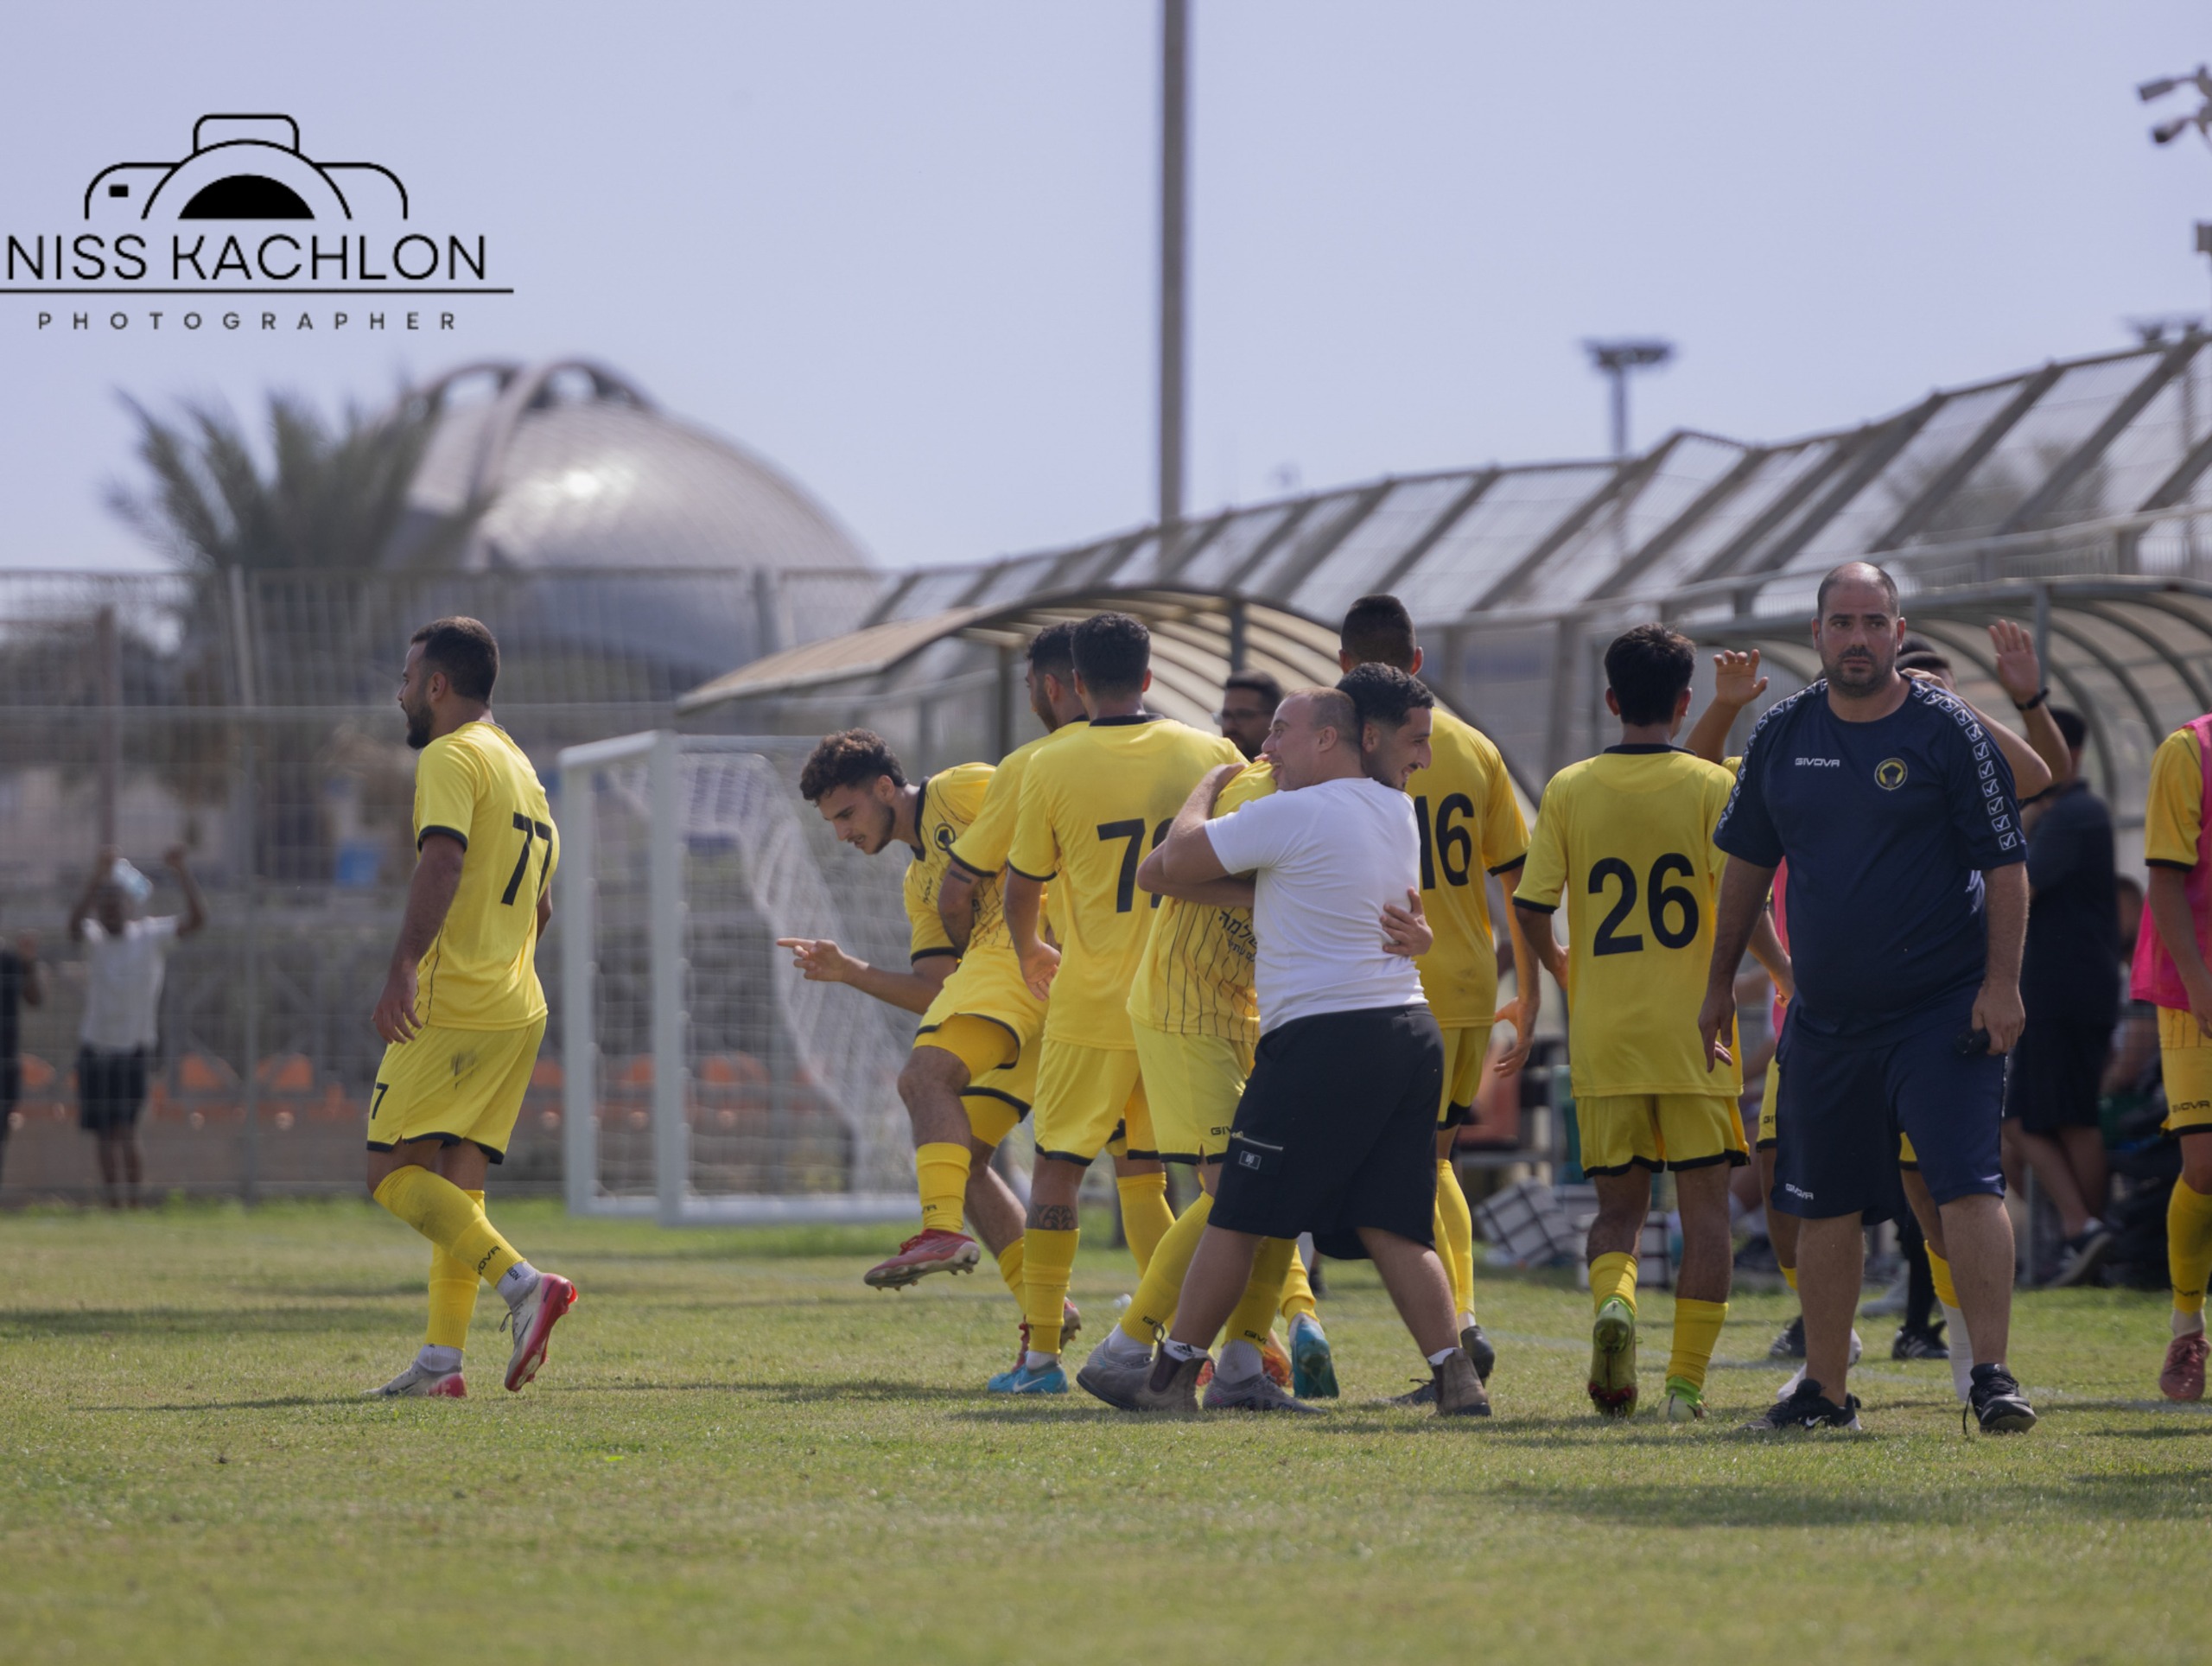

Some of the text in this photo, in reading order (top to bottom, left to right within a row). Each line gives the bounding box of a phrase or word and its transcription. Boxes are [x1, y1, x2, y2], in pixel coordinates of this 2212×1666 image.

[1795, 757, 1840, 767] GIVOVA
[501, 811, 553, 906] 77
[1414, 792, 1474, 891] 16
[1588, 852, 1699, 957] 26
